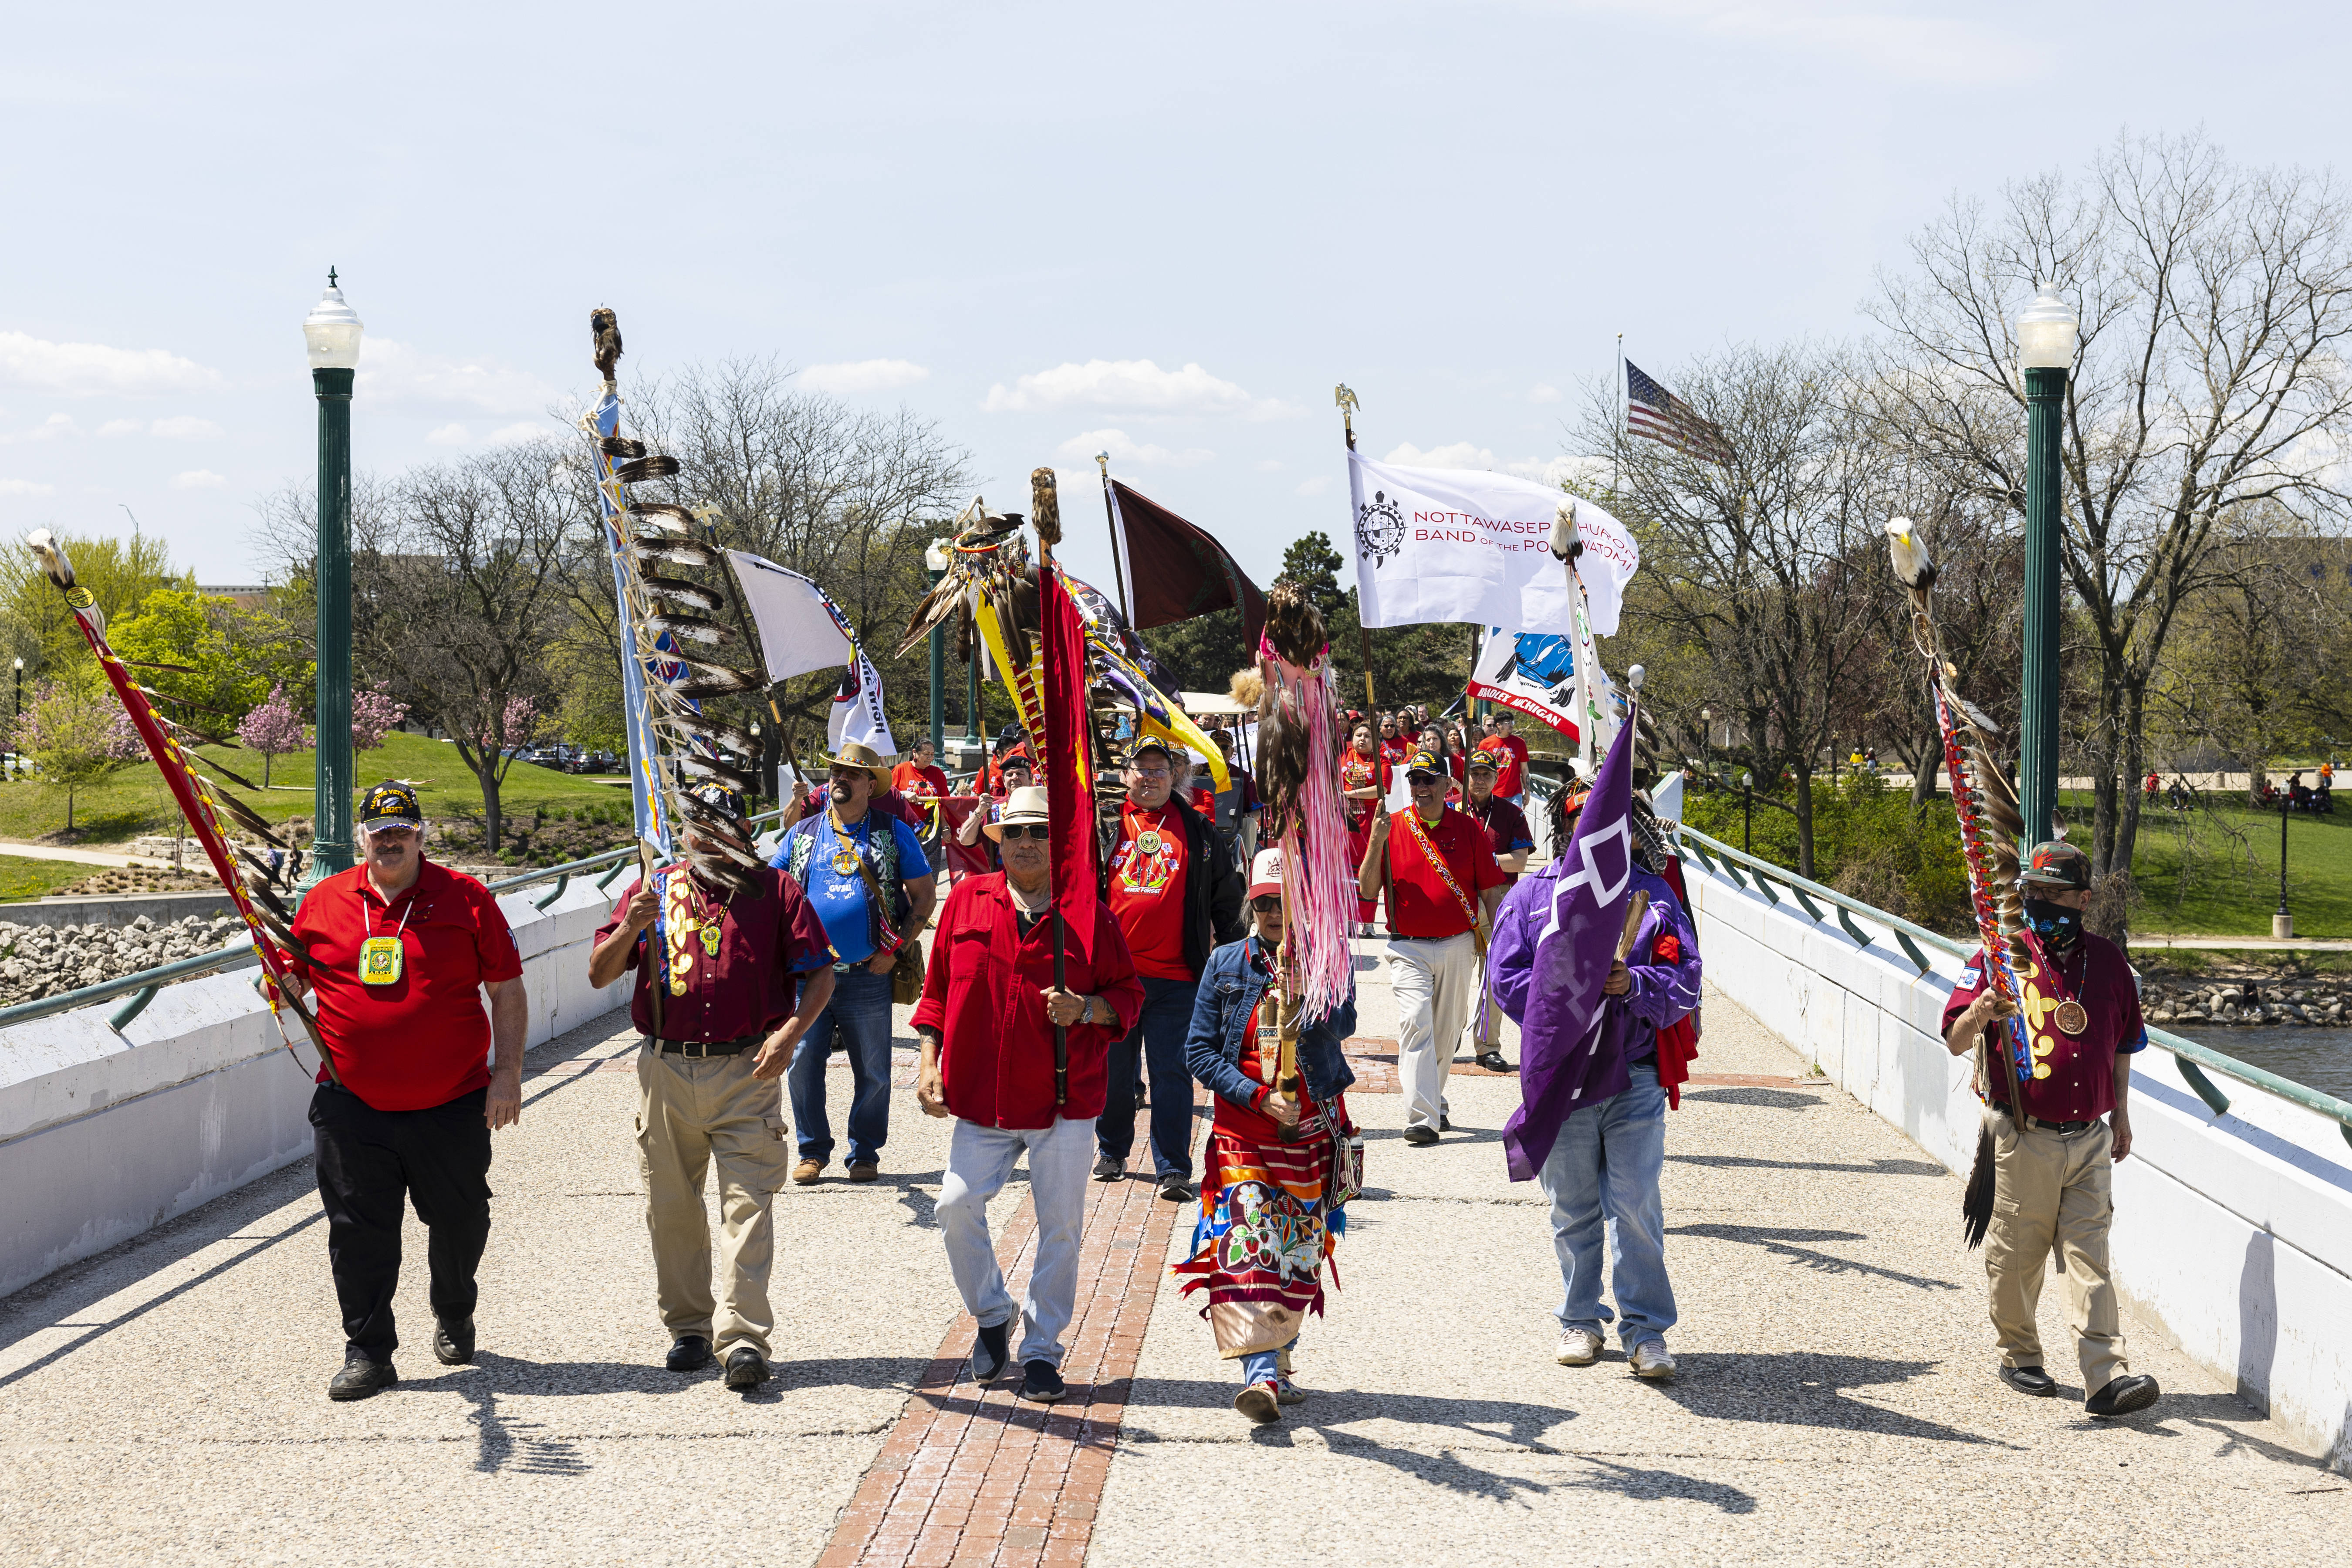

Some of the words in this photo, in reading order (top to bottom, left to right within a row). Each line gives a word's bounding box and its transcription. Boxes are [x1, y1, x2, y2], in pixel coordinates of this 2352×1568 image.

[1414, 511, 1551, 534] NOTTAWASEP
[1577, 522, 1636, 560] HURON
[1416, 529, 1476, 542] BAND
[1497, 543, 1519, 551] THE
[1524, 539, 1632, 571] POWATOMI
[1510, 698, 1561, 727] MICHIGAN
[370, 790, 388, 809] NATIVE
[388, 789, 413, 808] VETERAN
[380, 806, 404, 814] ARMY
[824, 891, 836, 900] POW
[843, 890, 855, 899] WOW
[829, 884, 852, 892] GVSU
